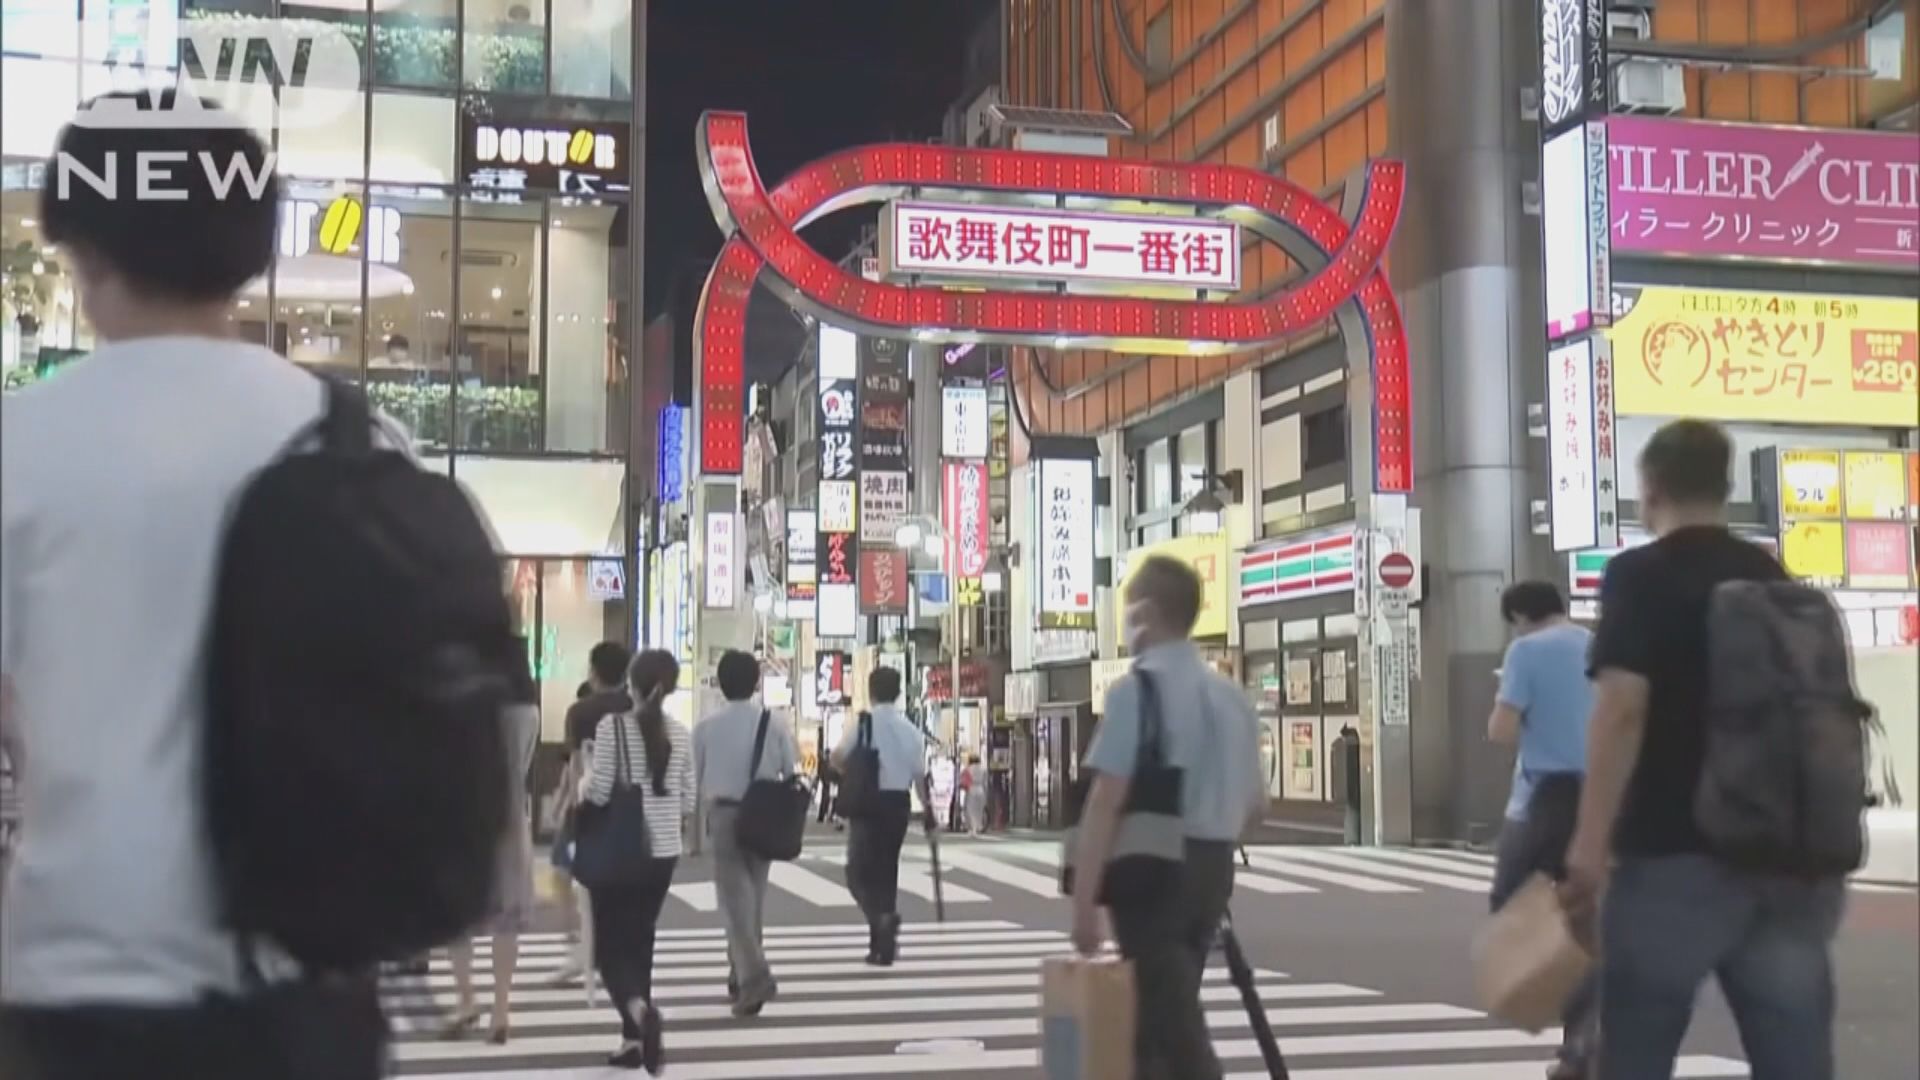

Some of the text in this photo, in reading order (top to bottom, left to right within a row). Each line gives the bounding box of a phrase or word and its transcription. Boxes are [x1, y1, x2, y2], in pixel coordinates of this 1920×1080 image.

[476, 125, 616, 170] DOUTOR
[1609, 144, 1773, 199] ILLER
[908, 216, 1224, 276] 歌舞伎町一番街
[1701, 211, 1842, 248] クリニック
[1712, 316, 1825, 358] やきとり
[1716, 358, 1833, 399] センター
